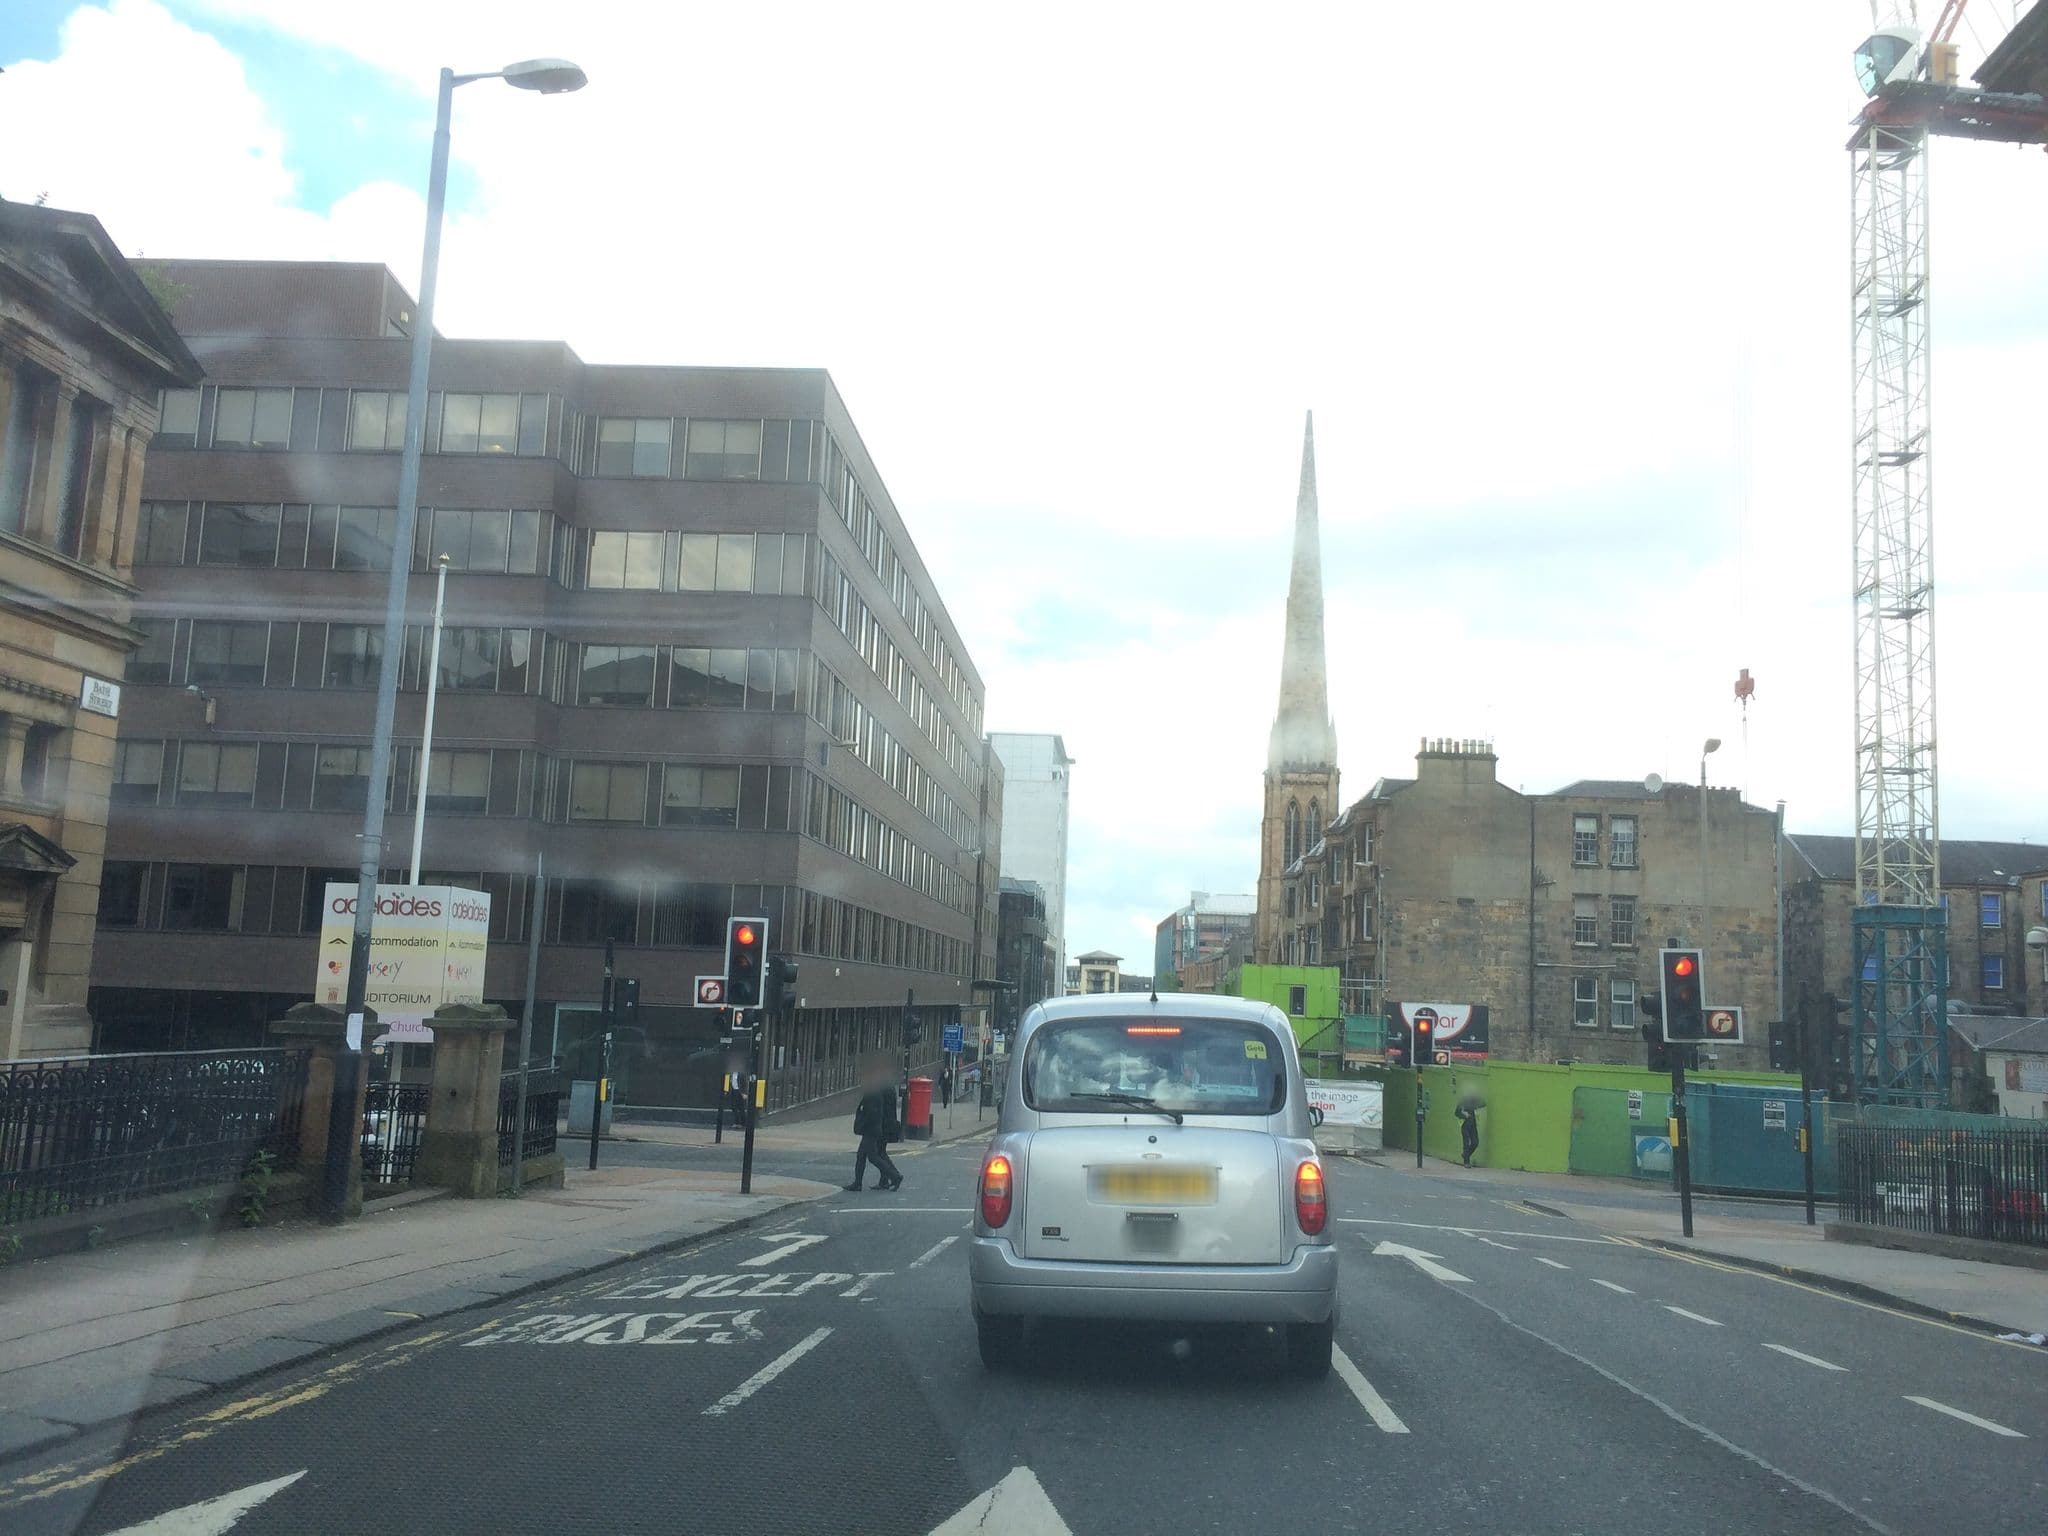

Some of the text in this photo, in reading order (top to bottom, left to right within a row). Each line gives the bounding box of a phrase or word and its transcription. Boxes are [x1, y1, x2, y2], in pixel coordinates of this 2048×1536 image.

[370, 936, 439, 948] commodation
[1311, 1090, 1359, 1103] the image
[599, 1272, 895, 1300] EXCEPT
[460, 1307, 767, 1347] BUSES
